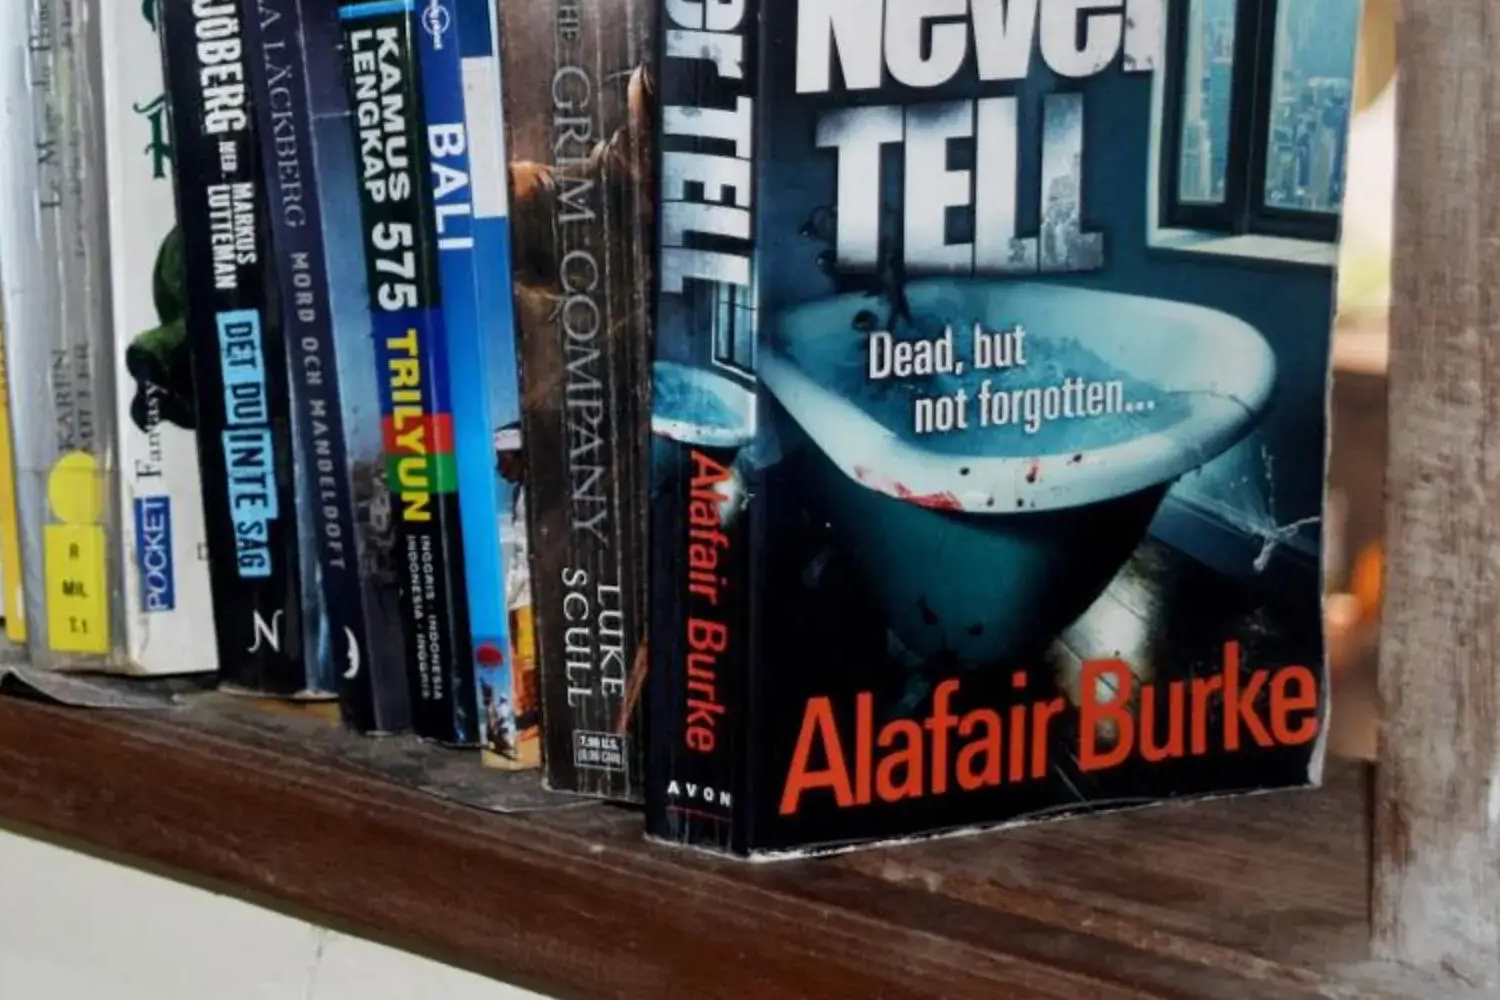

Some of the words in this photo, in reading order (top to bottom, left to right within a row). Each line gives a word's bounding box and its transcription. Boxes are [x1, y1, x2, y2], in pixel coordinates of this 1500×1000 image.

[263, 41, 307, 229] LÄCKBERG
[349, 29, 386, 203] LENGKAP
[374, 26, 412, 203] KAMUS
[551, 64, 595, 225] GRIM
[207, 184, 238, 290] LUTTEMAN
[231, 182, 257, 264] MARKUS
[427, 122, 475, 251] BALI
[660, 96, 752, 294] TELL
[816, 93, 1105, 279] TELL
[291, 251, 315, 323] MORD
[372, 222, 417, 312] 575
[224, 321, 257, 369] DET
[301, 337, 322, 385] OCH
[559, 249, 608, 549] COMPANY
[868, 325, 965, 379] Dead,
[973, 324, 1028, 372] but
[135, 380, 168, 481] Fantasy
[231, 380, 264, 426] DU
[385, 328, 431, 522] TRILYUN
[913, 389, 967, 434] not
[978, 376, 1156, 434] forgotten...
[230, 431, 269, 509] INTE
[308, 399, 345, 571] MANDELDOFT
[688, 449, 732, 605] Alafair
[138, 497, 172, 612] POCKET
[405, 534, 423, 620] INDONESIA
[248, 609, 284, 654] N
[426, 614, 443, 700] INDONESIA
[562, 567, 592, 707] SCULL
[597, 581, 627, 699] LUKE
[684, 619, 728, 753] Burke
[778, 670, 1066, 816] Alafair
[1077, 641, 1320, 773] Burke
[667, 779, 732, 807] AVON
